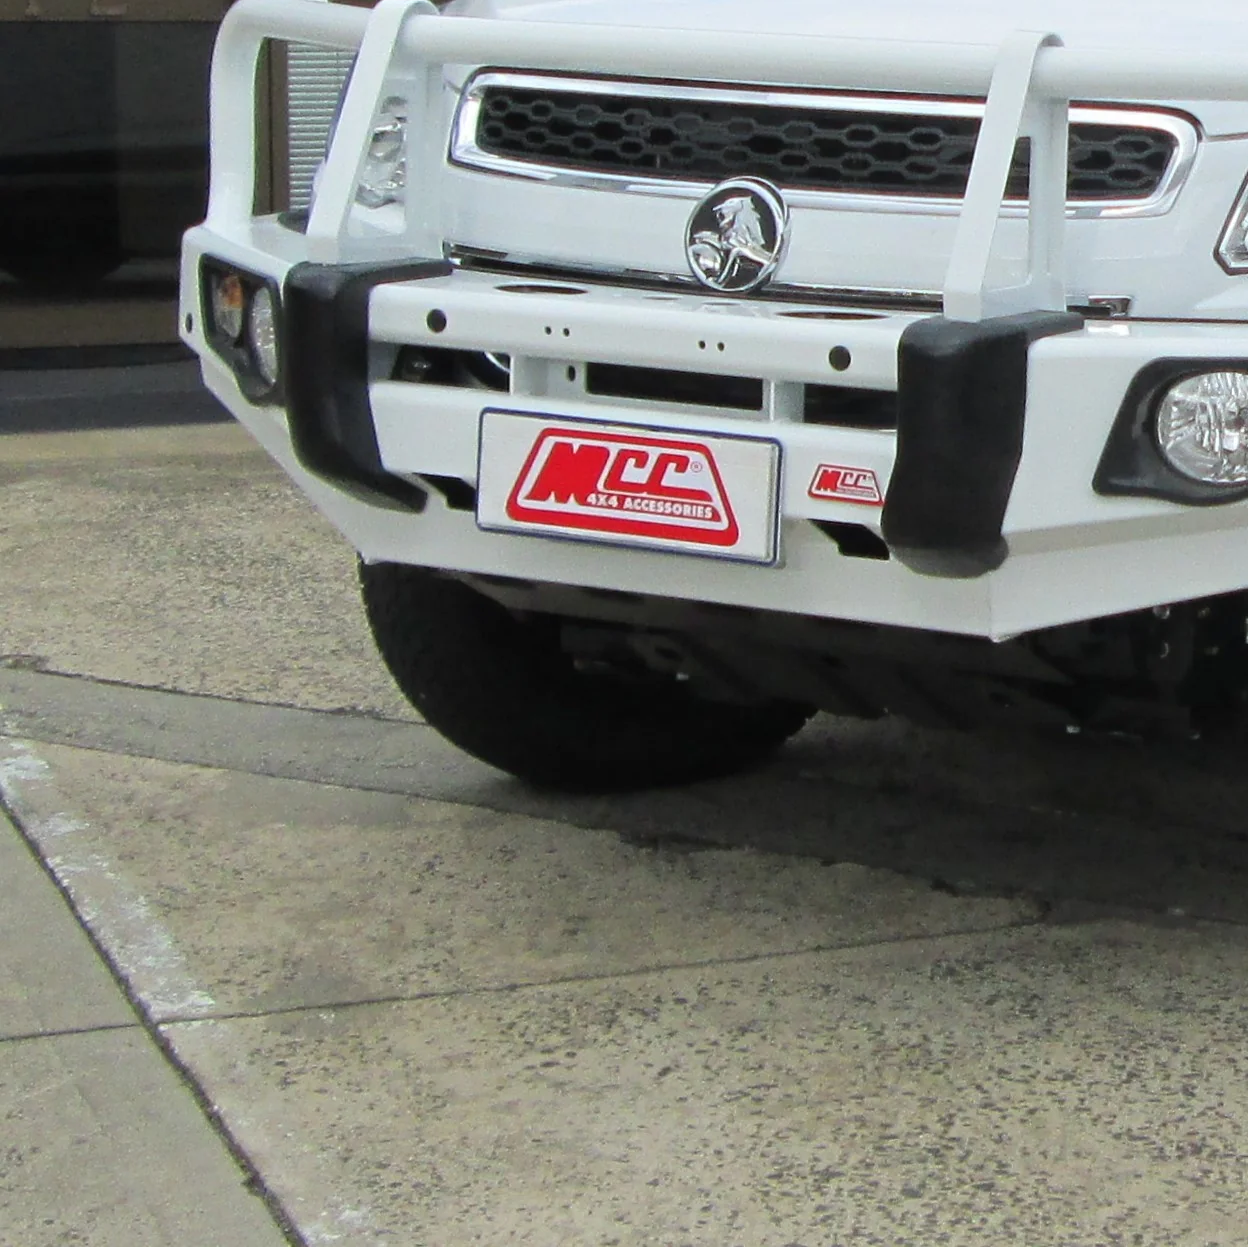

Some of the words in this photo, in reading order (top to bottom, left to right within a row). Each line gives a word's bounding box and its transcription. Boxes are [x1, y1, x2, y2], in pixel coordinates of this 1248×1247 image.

[524, 442, 714, 506] MCC
[586, 493, 619, 508] 4X4
[623, 498, 713, 519] ACCESSORIES
